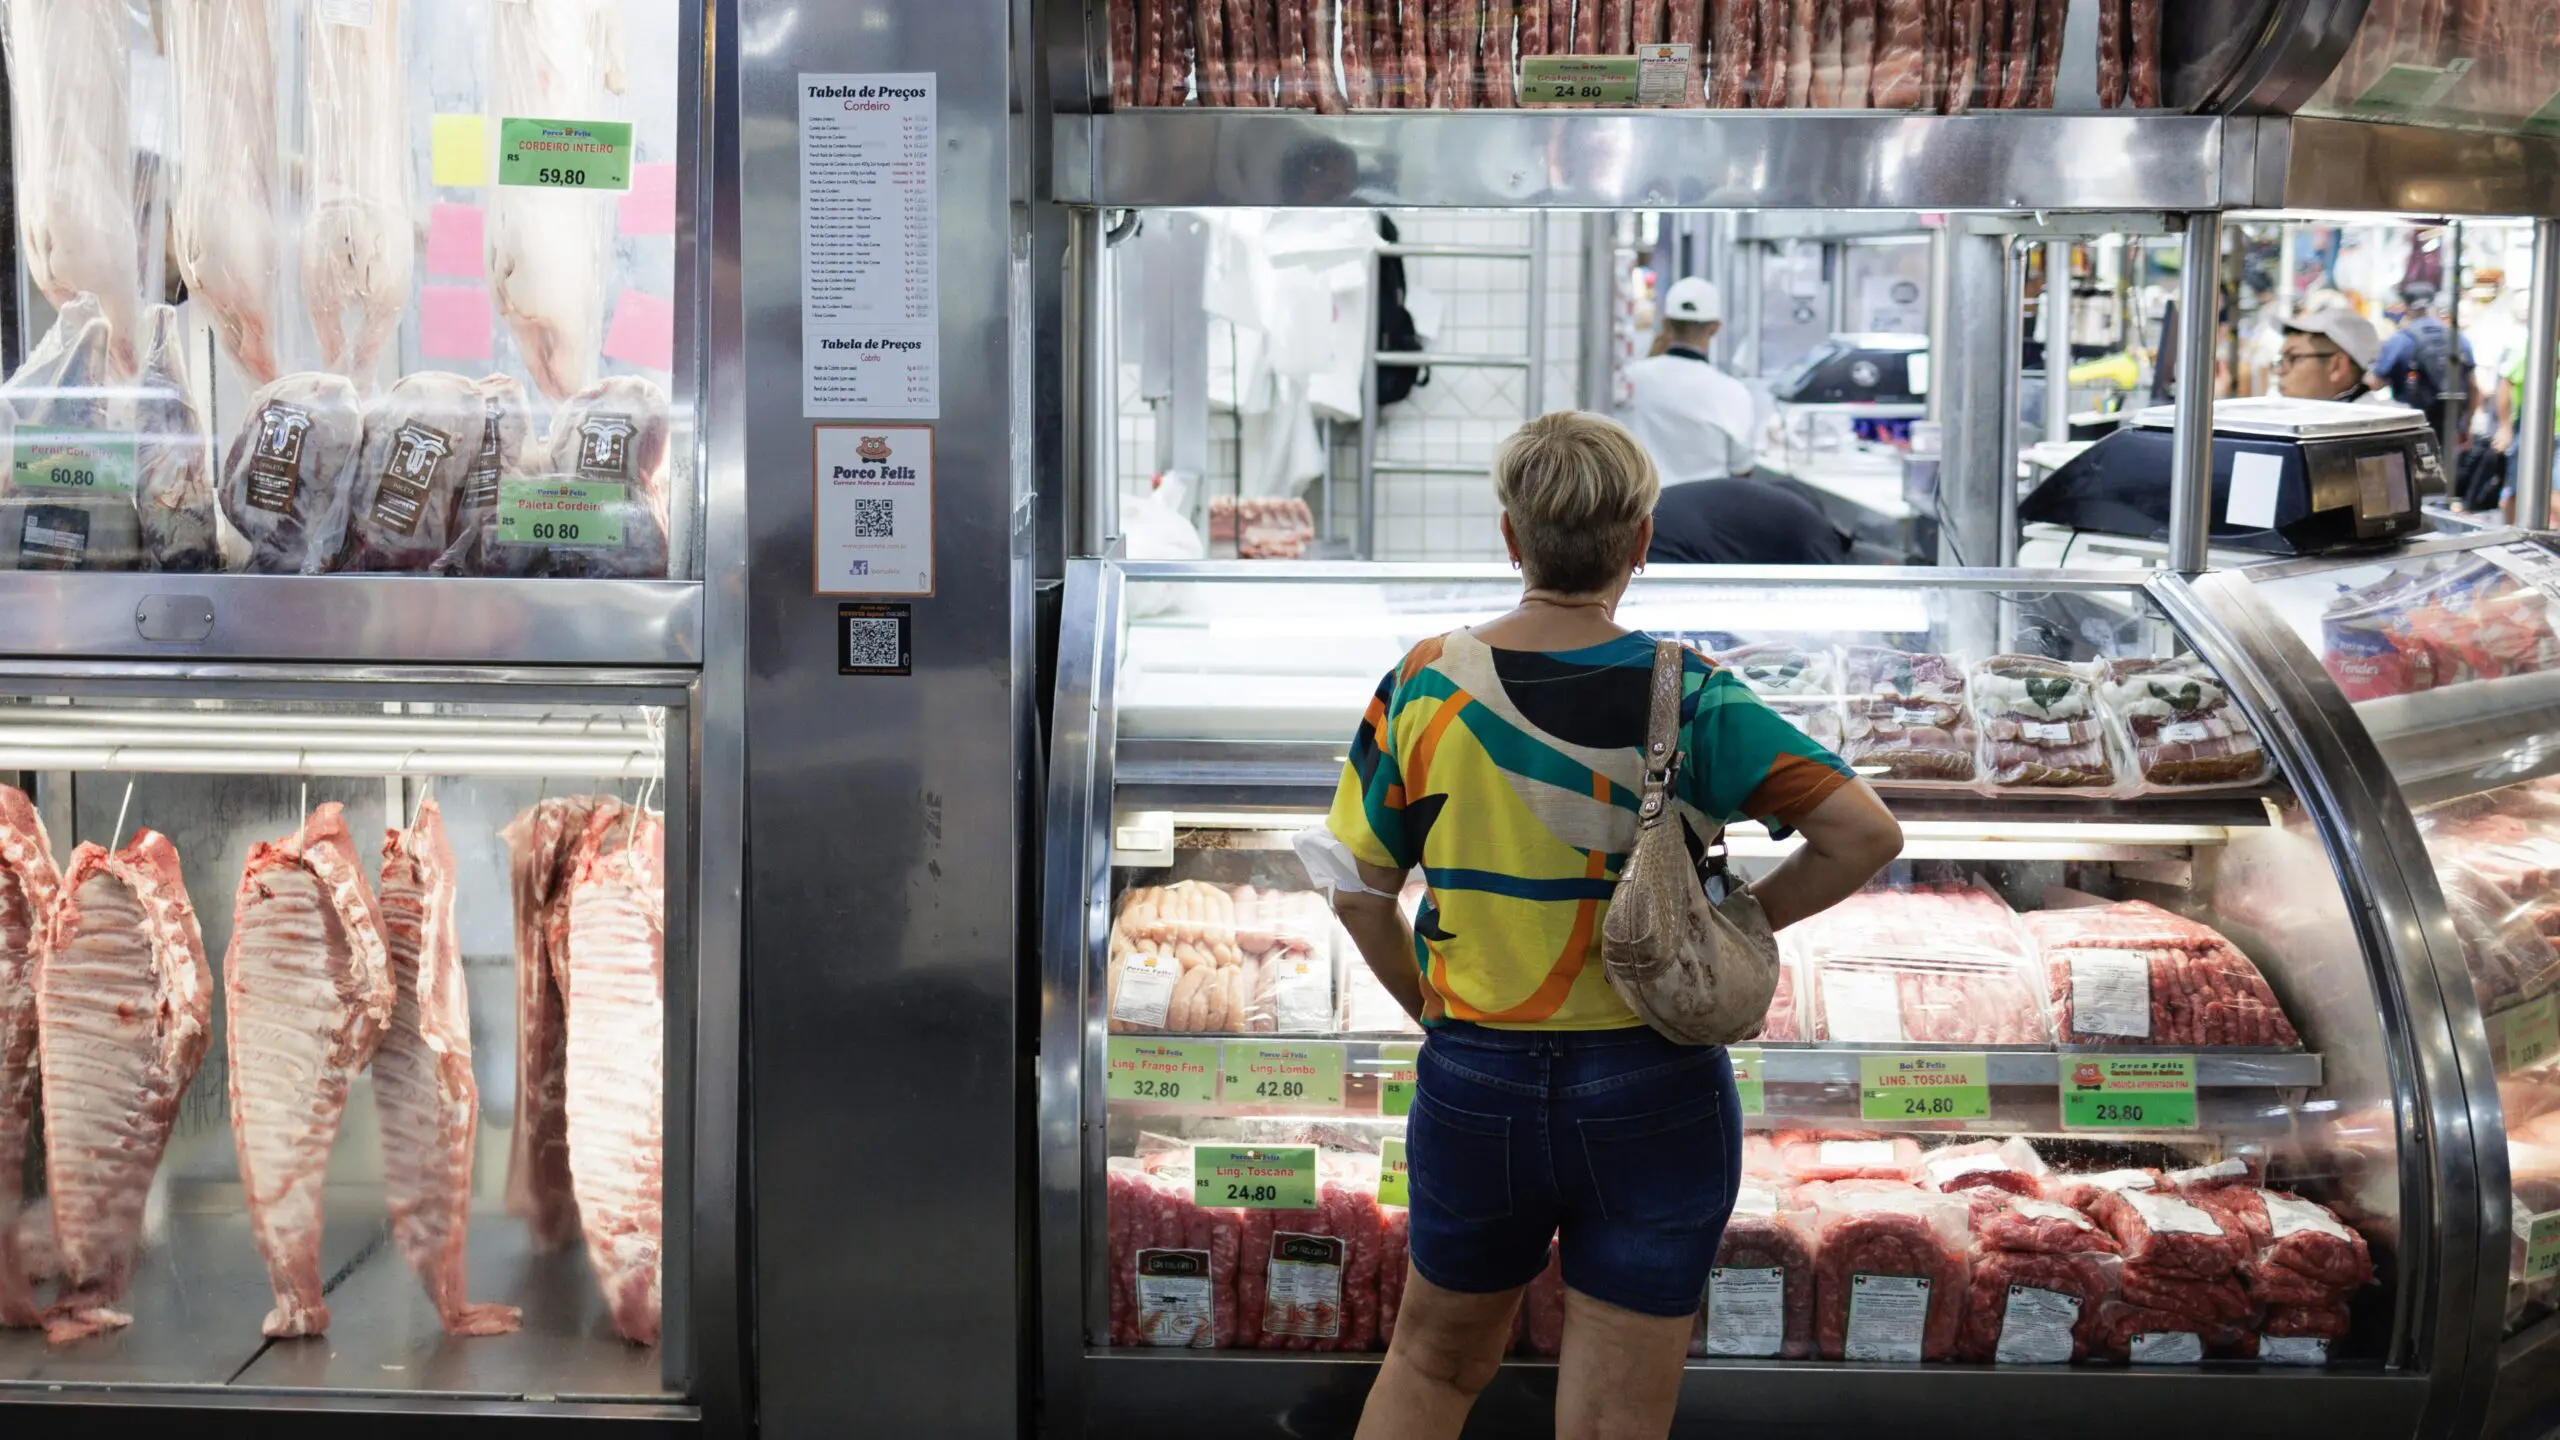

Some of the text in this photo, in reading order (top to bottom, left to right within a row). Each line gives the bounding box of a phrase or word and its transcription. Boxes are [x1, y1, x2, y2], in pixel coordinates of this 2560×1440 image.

[1537, 74, 1577, 82] Costela
[1600, 73, 1628, 82] Tiras
[808, 86, 926, 101] Tabela de Preços
[844, 101, 890, 112] Cordeiro
[542, 129, 563, 137] Porco
[519, 140, 614, 154] CORDEIRO INTEIRO
[507, 153, 520, 161] R$
[539, 168, 585, 186] 59,80
[821, 339, 922, 353] Tabela de Preços
[31, 444, 63, 456] Pernil
[51, 468, 94, 486] 60,80
[833, 466, 916, 479] Porco Feliz
[518, 499, 553, 511] Paleta
[1112, 1058, 1205, 1074] Ling. Frango Fina
[1250, 1063, 1316, 1075] Ling. Lombo
[1899, 1062, 1914, 1070] Boi
[1225, 1075, 1238, 1083] R$
[1879, 1074, 1968, 1086] LING. TOSCANA
[1134, 1080, 1180, 1098] 32,80
[1387, 1084, 1401, 1093] R$
[1905, 1097, 1954, 1115] 24,80
[2096, 1104, 2143, 1121] 28,80
[1216, 1166, 1294, 1178] Ling. Toscana
[1197, 1179, 1209, 1187] R$
[1381, 1174, 1394, 1183] R$
[1227, 1184, 1277, 1201] 24,80
